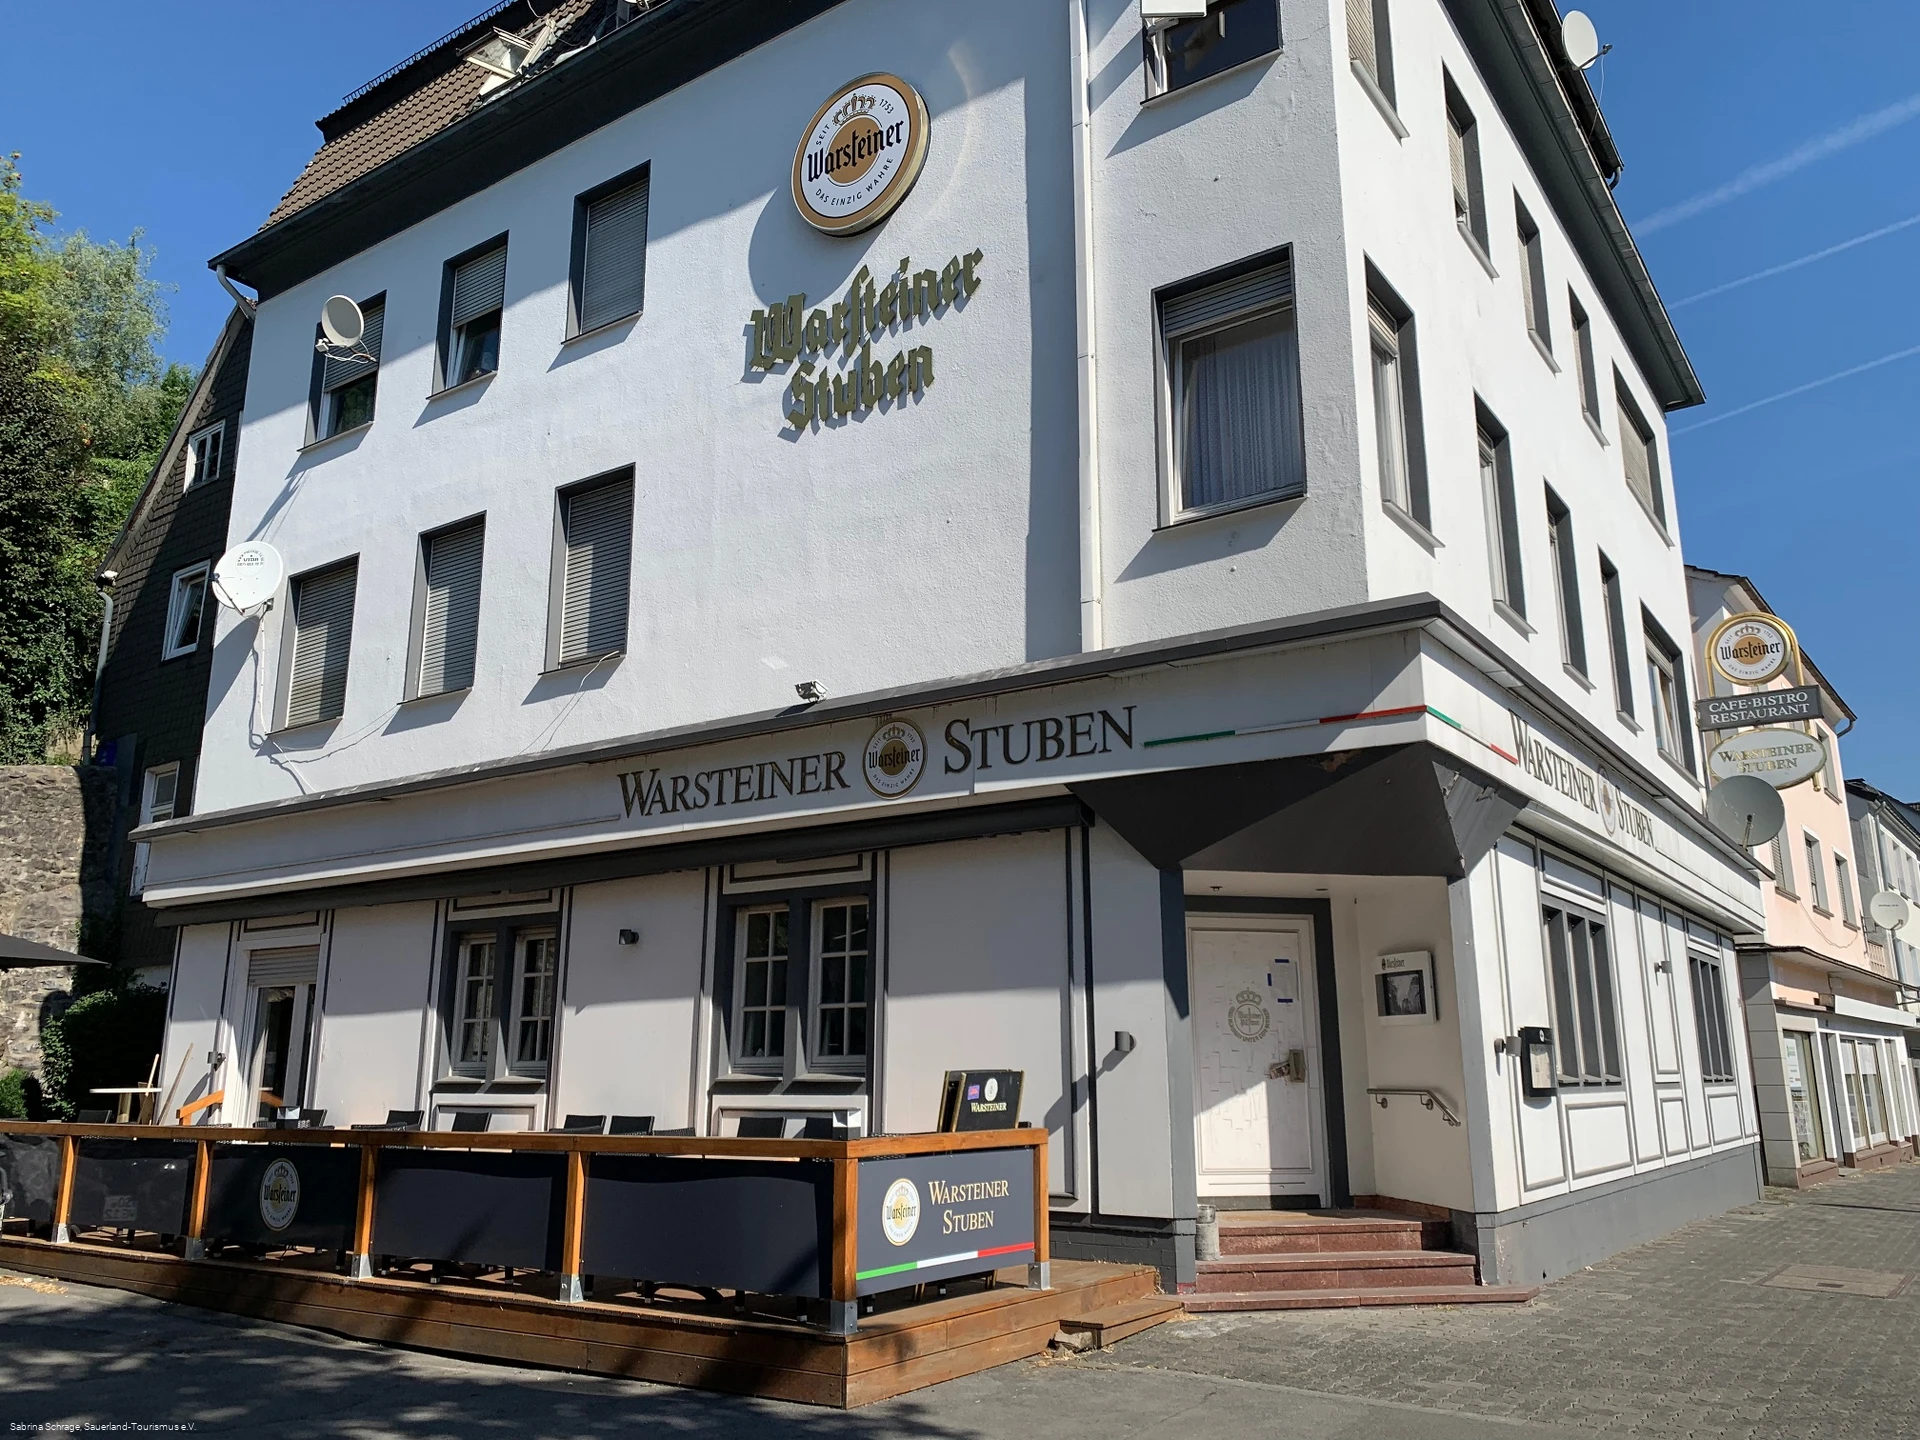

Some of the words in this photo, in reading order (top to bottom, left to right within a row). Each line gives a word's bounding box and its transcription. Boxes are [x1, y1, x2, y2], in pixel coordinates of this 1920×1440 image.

[816, 124, 830, 145] SEIT
[879, 99, 894, 114] 1753
[807, 120, 904, 182] Warsteiner
[815, 188, 829, 202] DAS
[831, 191, 862, 205] EINZIG
[866, 158, 893, 192] WAHRE
[787, 338, 935, 430] Stuben
[1720, 642, 1780, 660] Warsteiner
[1710, 703, 1810, 724] RESTAURANT
[617, 750, 852, 819] WARSTEINER
[943, 705, 1137, 775] STUBEN
[868, 746, 920, 768] Warsteiner
[1718, 742, 1817, 762] WARSTEINER
[1508, 708, 1599, 815] WARSTEINER
[1615, 785, 1655, 848] STUBEN
[1737, 758, 1798, 773] STUBEN
[971, 1102, 1007, 1112] WARSTEINER
[928, 1180, 1009, 1205] WARSTEINER
[943, 1210, 994, 1235] STUBEN
